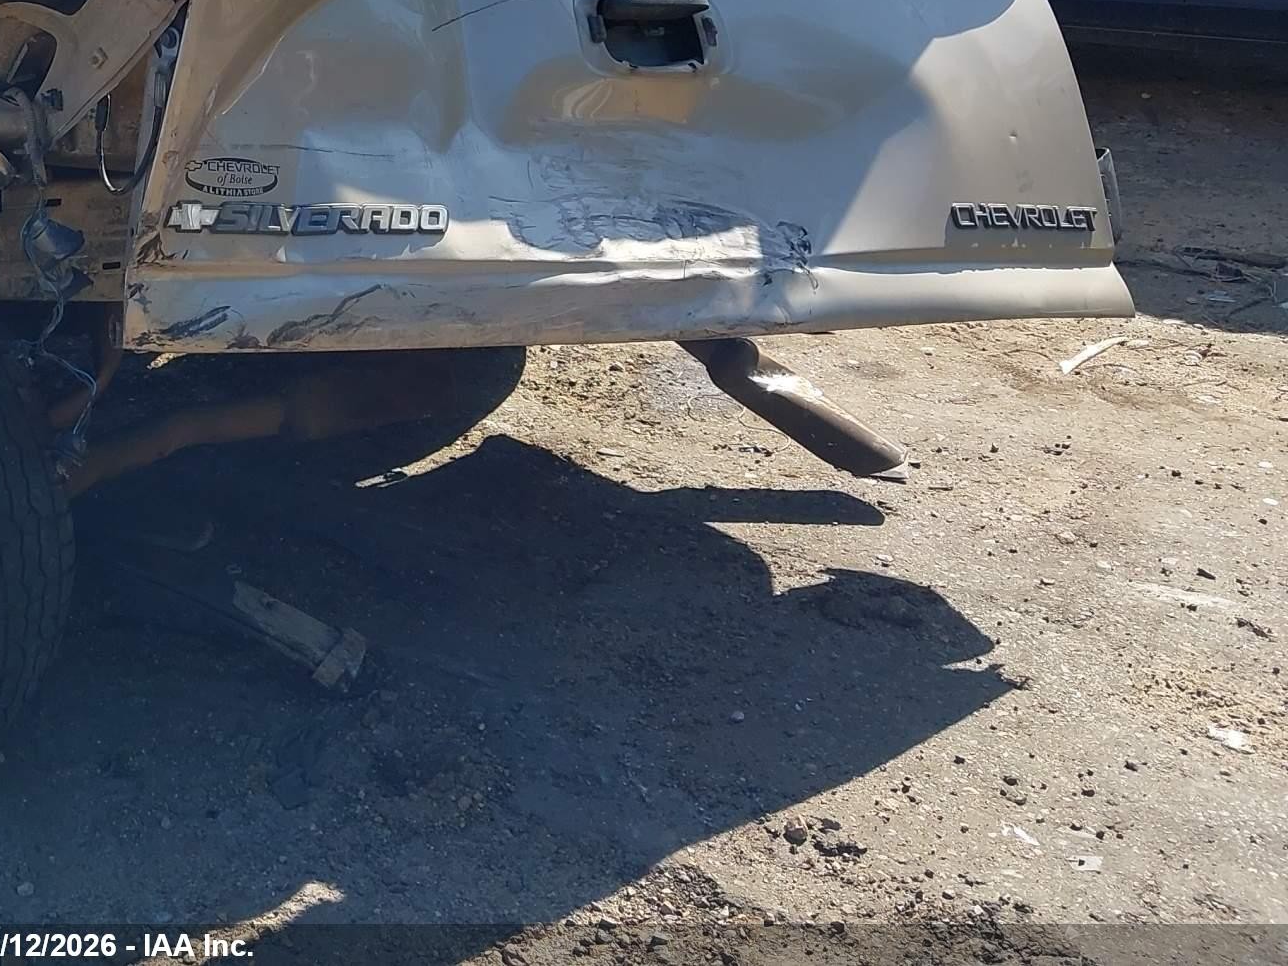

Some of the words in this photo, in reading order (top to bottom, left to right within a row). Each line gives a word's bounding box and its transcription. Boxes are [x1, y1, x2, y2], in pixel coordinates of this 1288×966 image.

[207, 160, 281, 175] CHEVROLET
[216, 173, 229, 187] of
[229, 173, 253, 186] Boise
[212, 202, 449, 235] SILVERADO
[949, 202, 1099, 232] CHEVROLET
